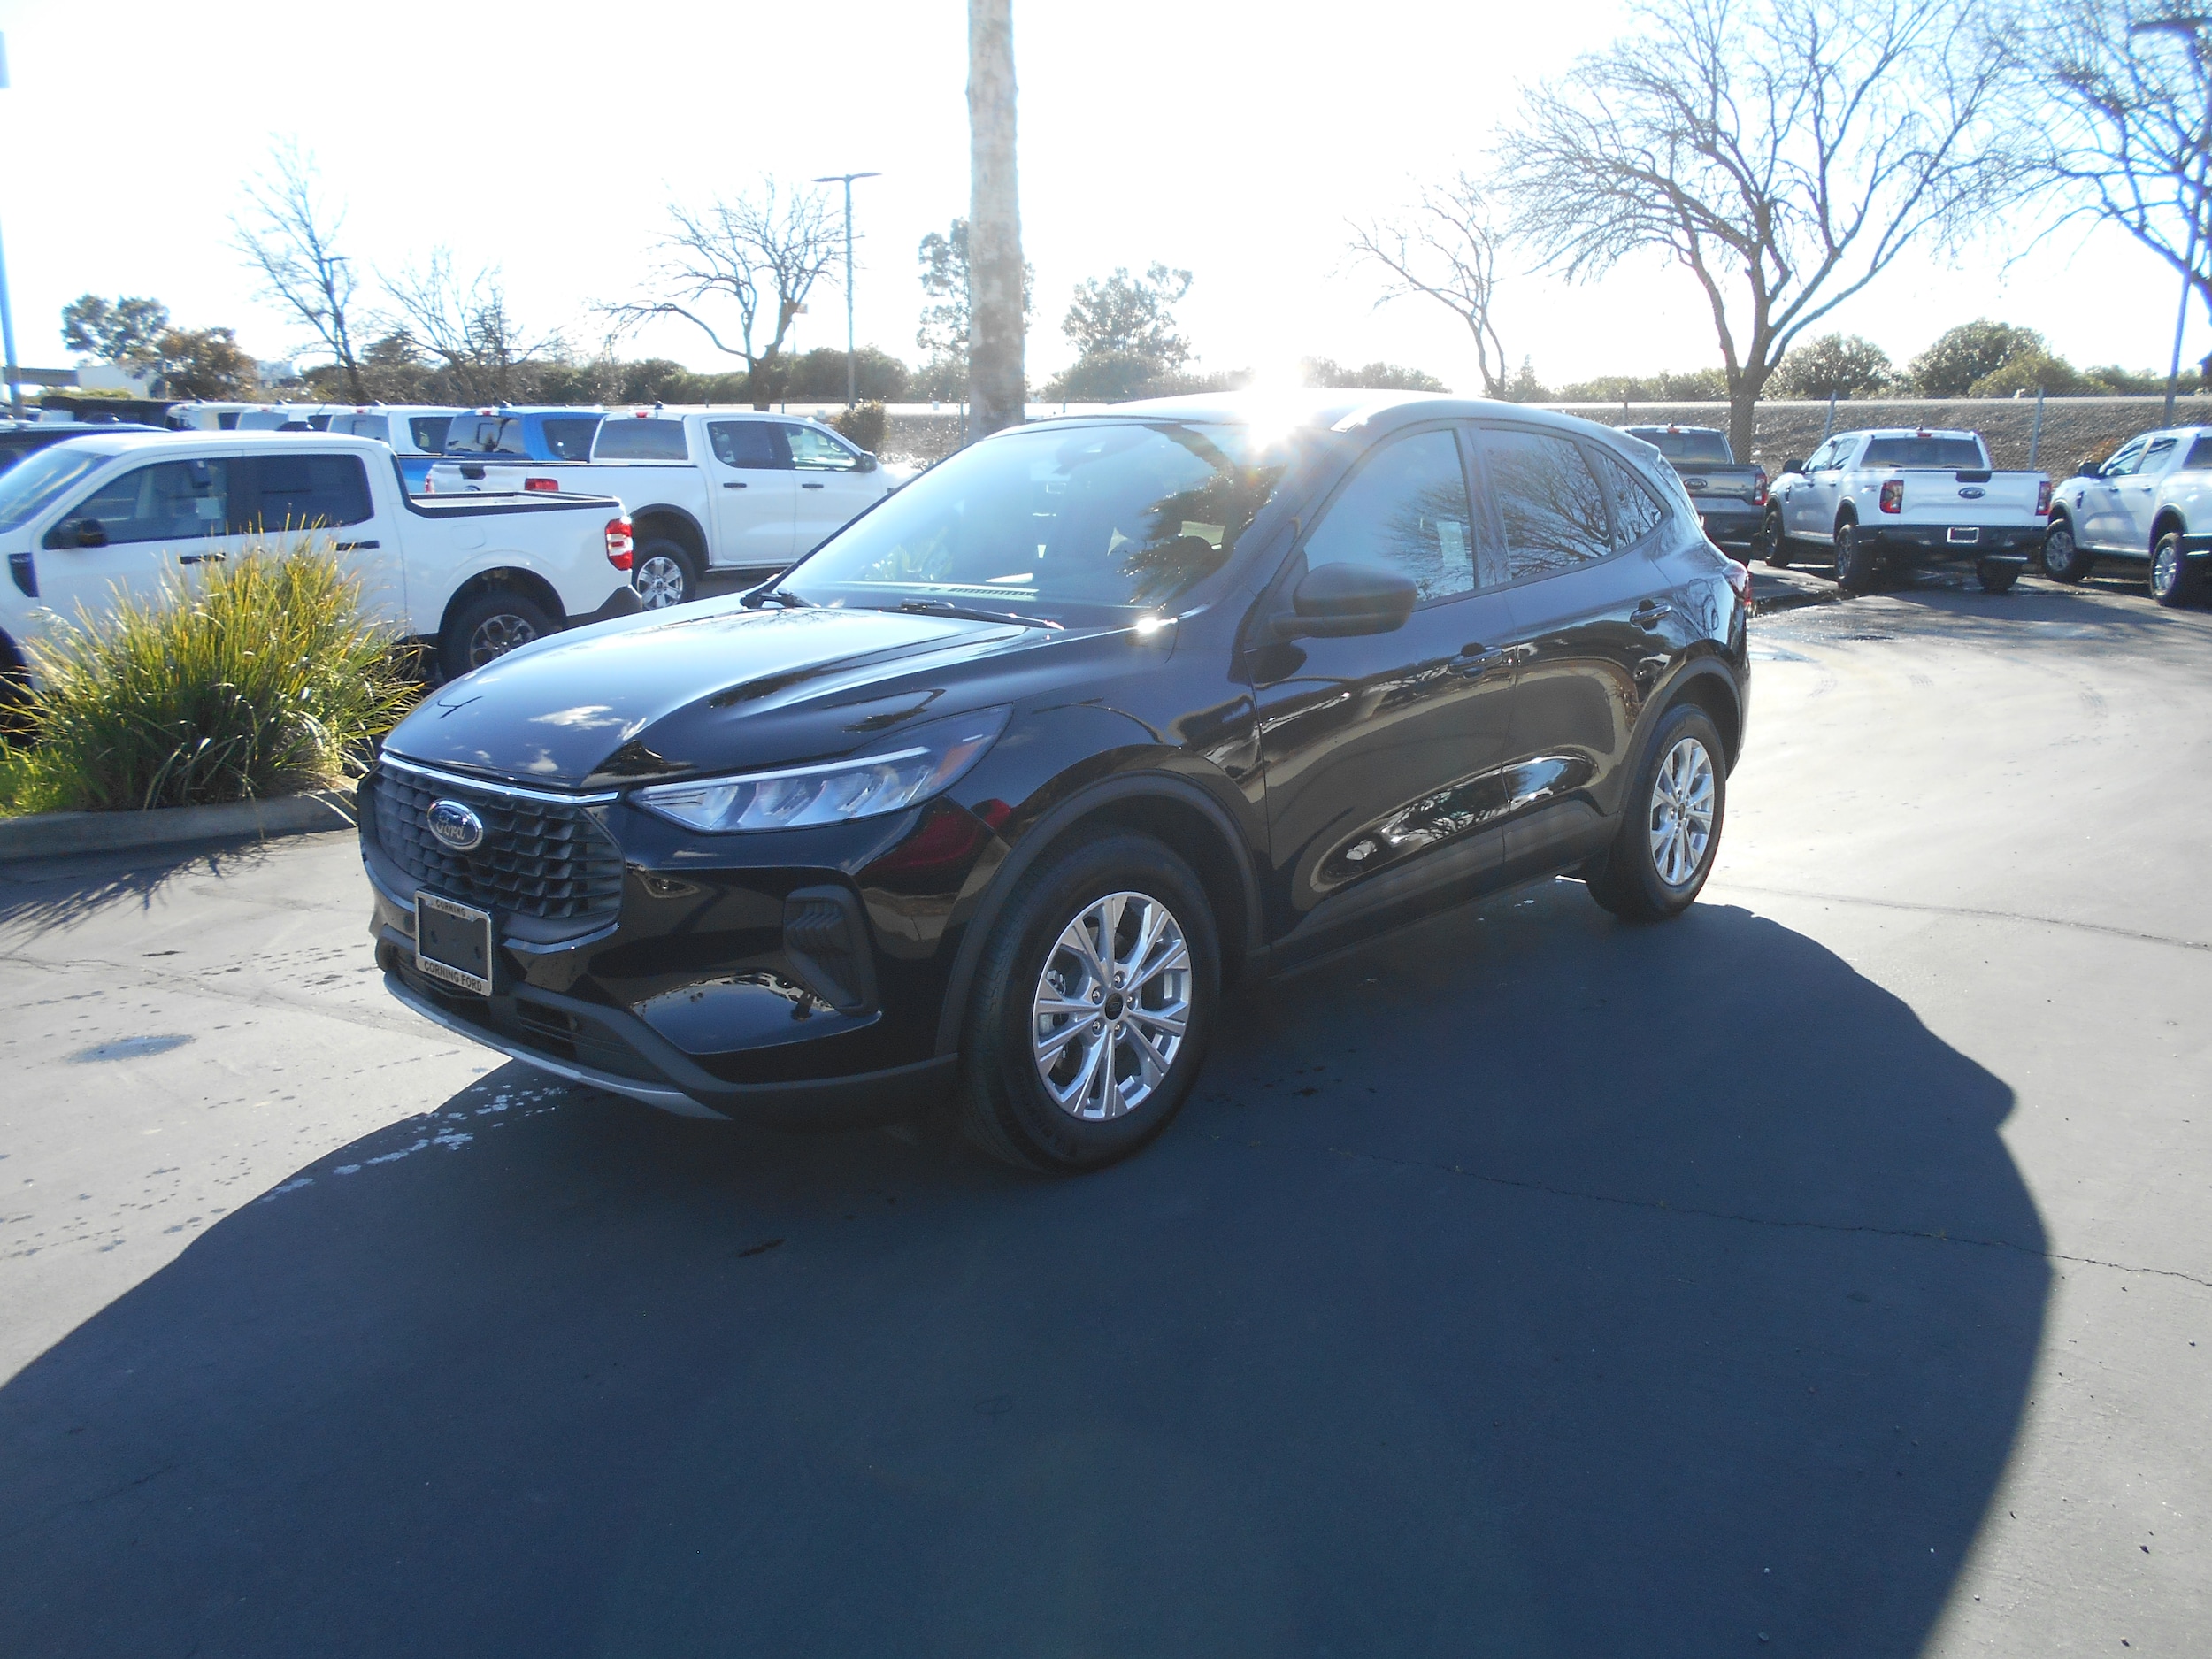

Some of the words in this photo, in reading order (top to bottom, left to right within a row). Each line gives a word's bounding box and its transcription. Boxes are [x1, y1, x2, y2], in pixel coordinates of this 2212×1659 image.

[435, 811, 466, 840] Ford
[424, 961, 459, 983] CORNING
[461, 974, 482, 992] FORD
